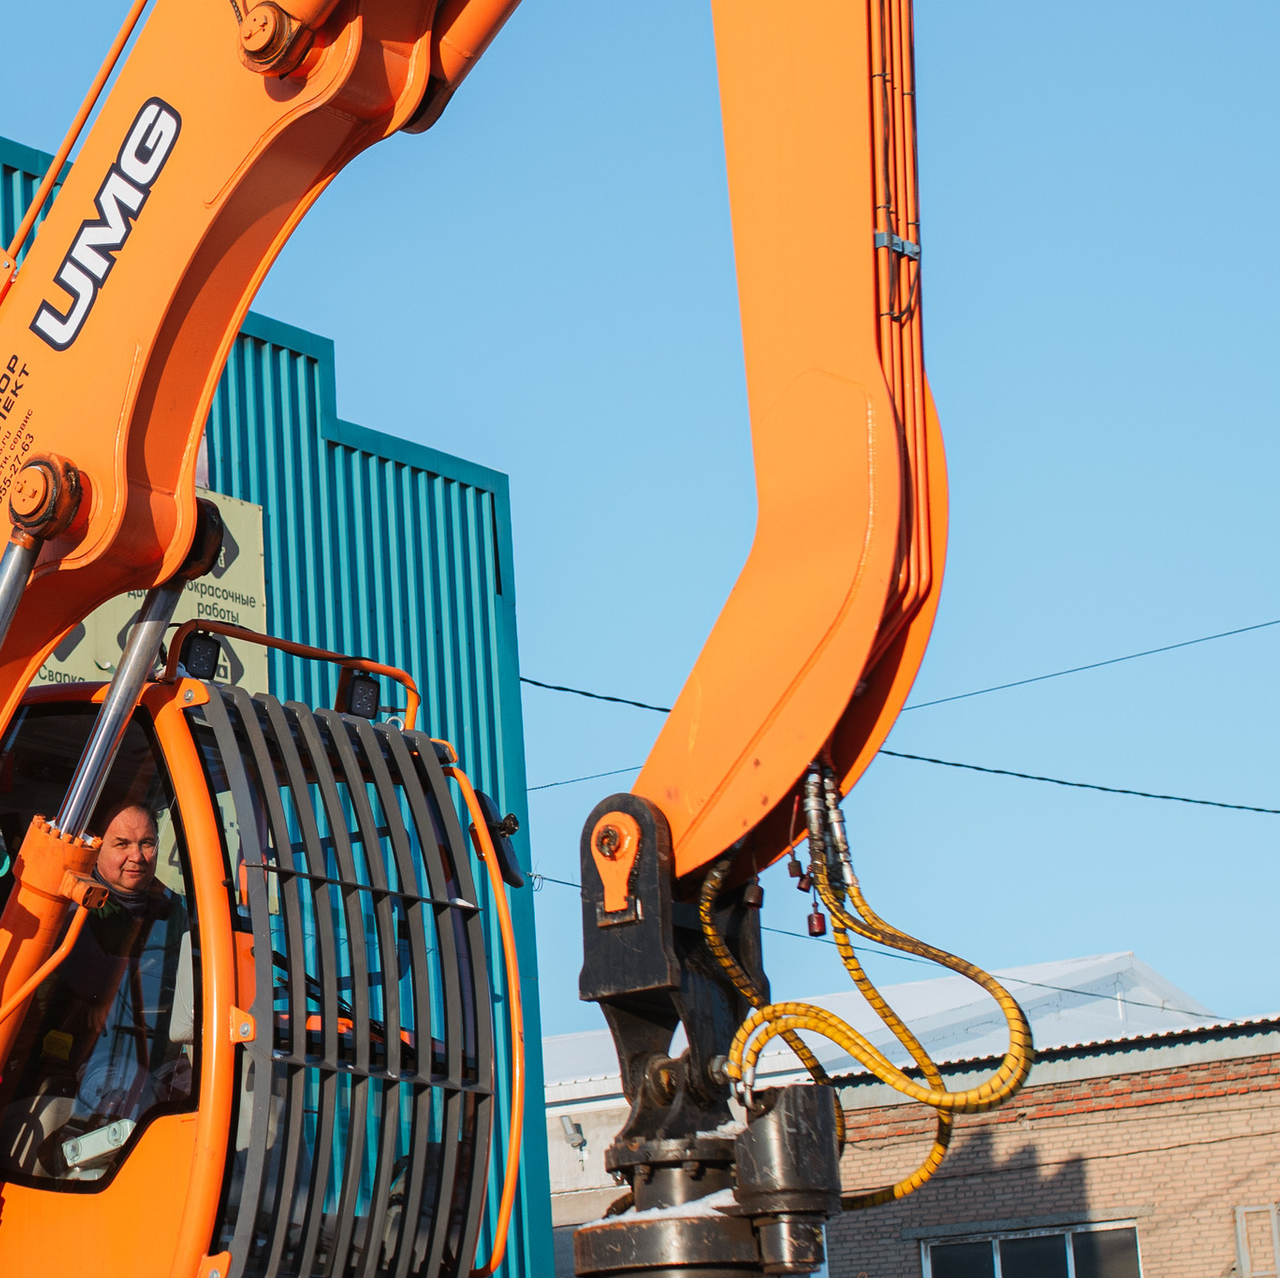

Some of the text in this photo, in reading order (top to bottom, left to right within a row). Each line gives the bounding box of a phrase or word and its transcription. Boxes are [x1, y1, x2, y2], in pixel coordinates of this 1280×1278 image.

[30, 97, 181, 350] UMG
[9, 408, 34, 451] сервис
[184, 580, 256, 608] окрасочные
[197, 602, 239, 624] работы
